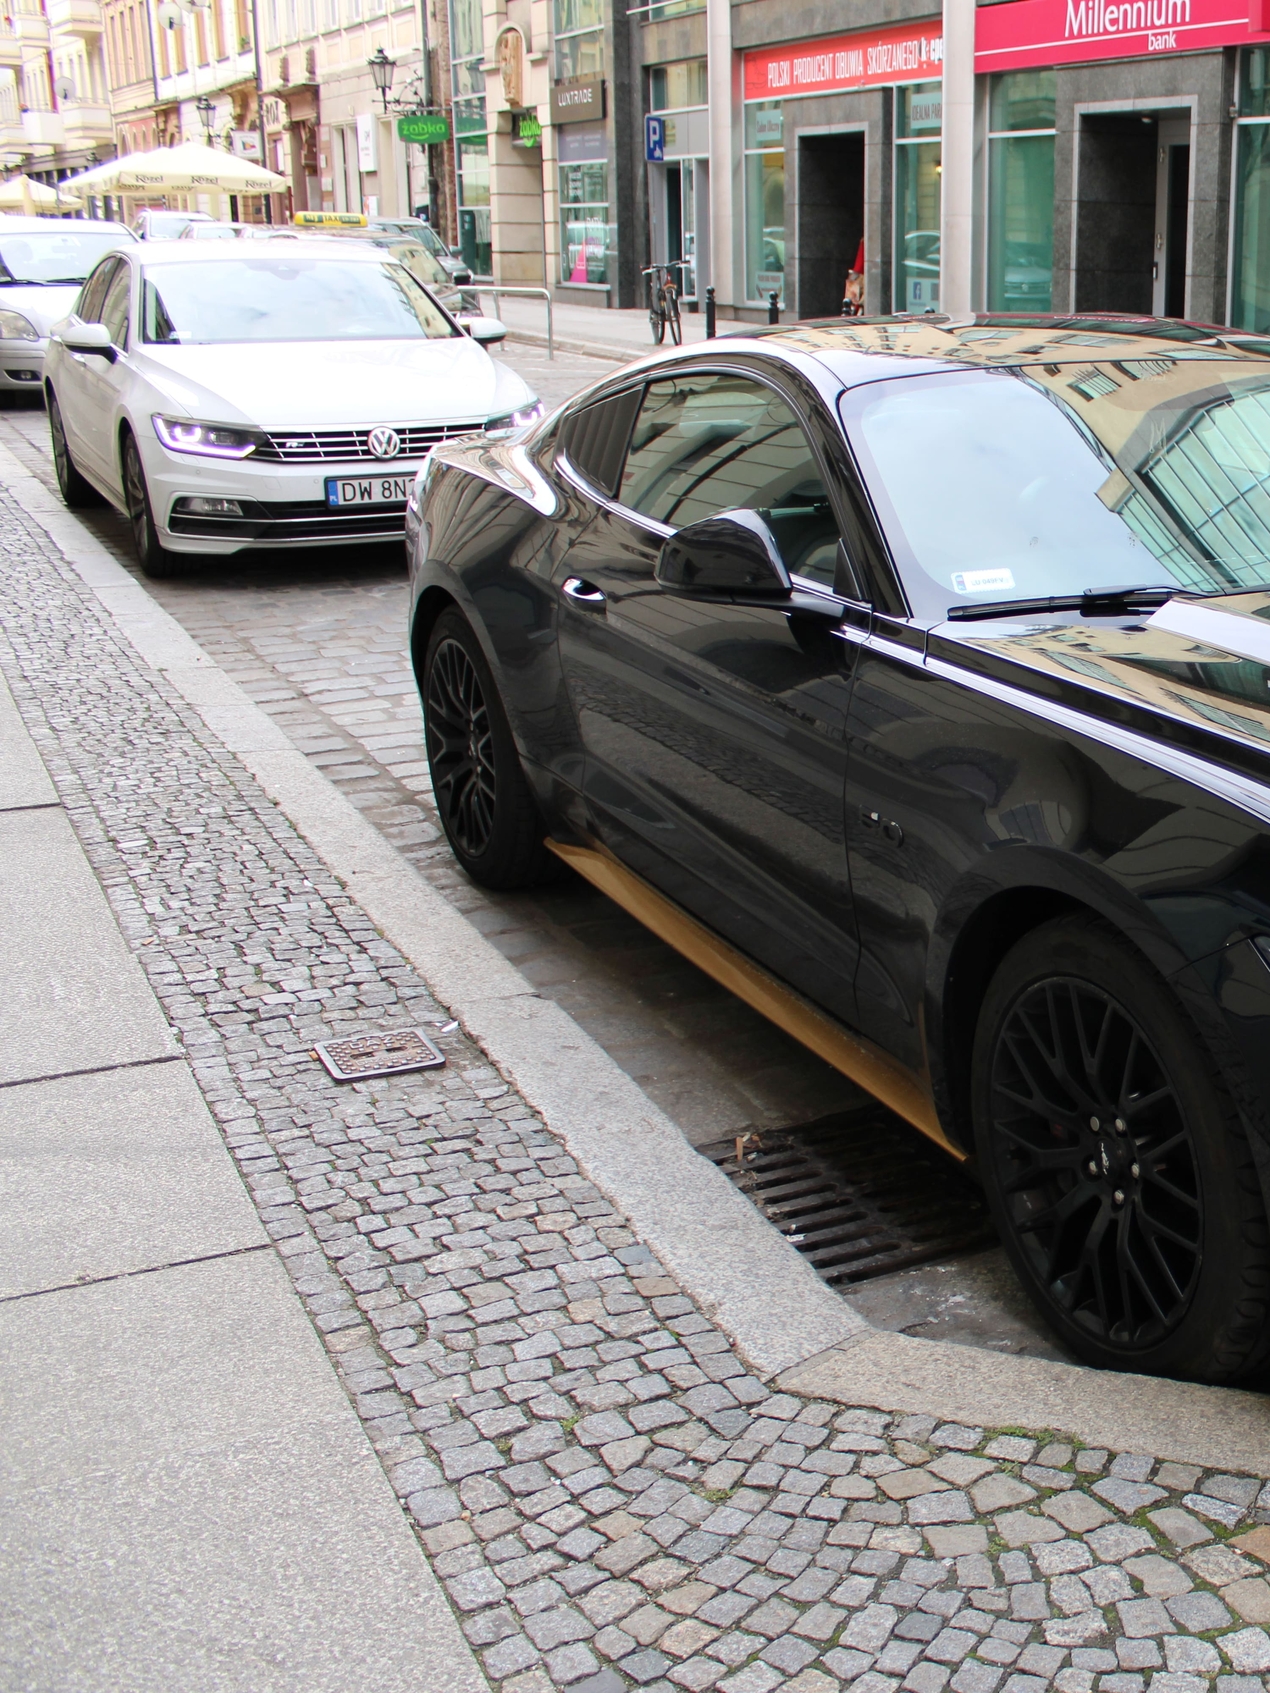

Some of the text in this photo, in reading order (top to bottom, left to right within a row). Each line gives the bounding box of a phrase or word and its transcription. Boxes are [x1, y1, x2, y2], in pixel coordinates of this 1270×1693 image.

[1064, 0, 1190, 37] Millennium
[1148, 31, 1177, 51] bank
[767, 41, 919, 88] POLSKI PRODUCENT OBUWIA SKÓRZANEGO
[557, 88, 593, 107] LUXTRADE
[402, 121, 445, 135] żabka
[650, 121, 660, 148] P
[342, 482, 372, 502] DW
